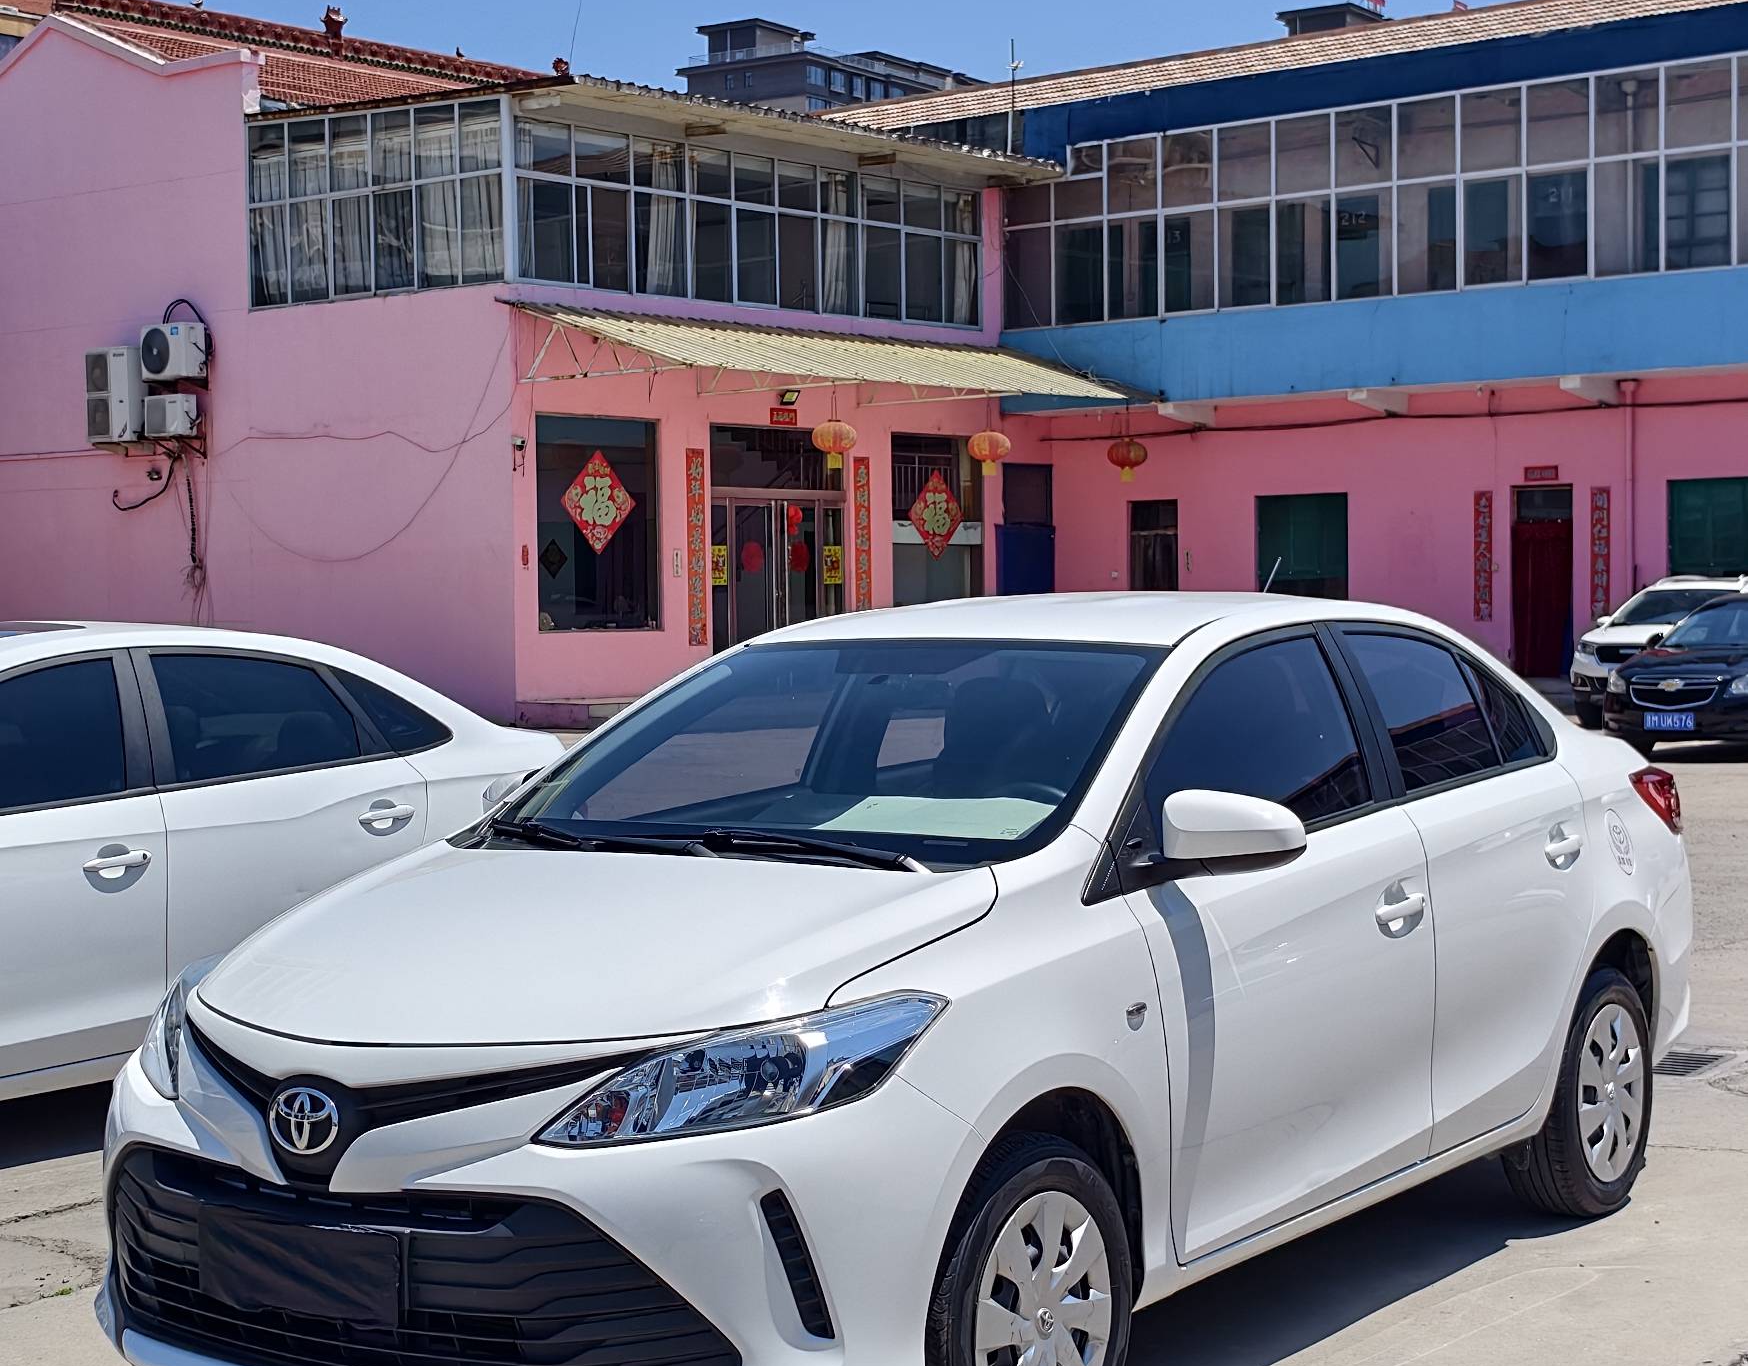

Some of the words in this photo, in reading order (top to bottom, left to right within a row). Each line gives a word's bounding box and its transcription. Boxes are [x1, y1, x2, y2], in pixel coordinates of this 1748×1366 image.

[1340, 210, 1368, 226] 212
[579, 476, 617, 527] 福
[922, 491, 951, 536] 福
[1660, 714, 1693, 728] UK576
